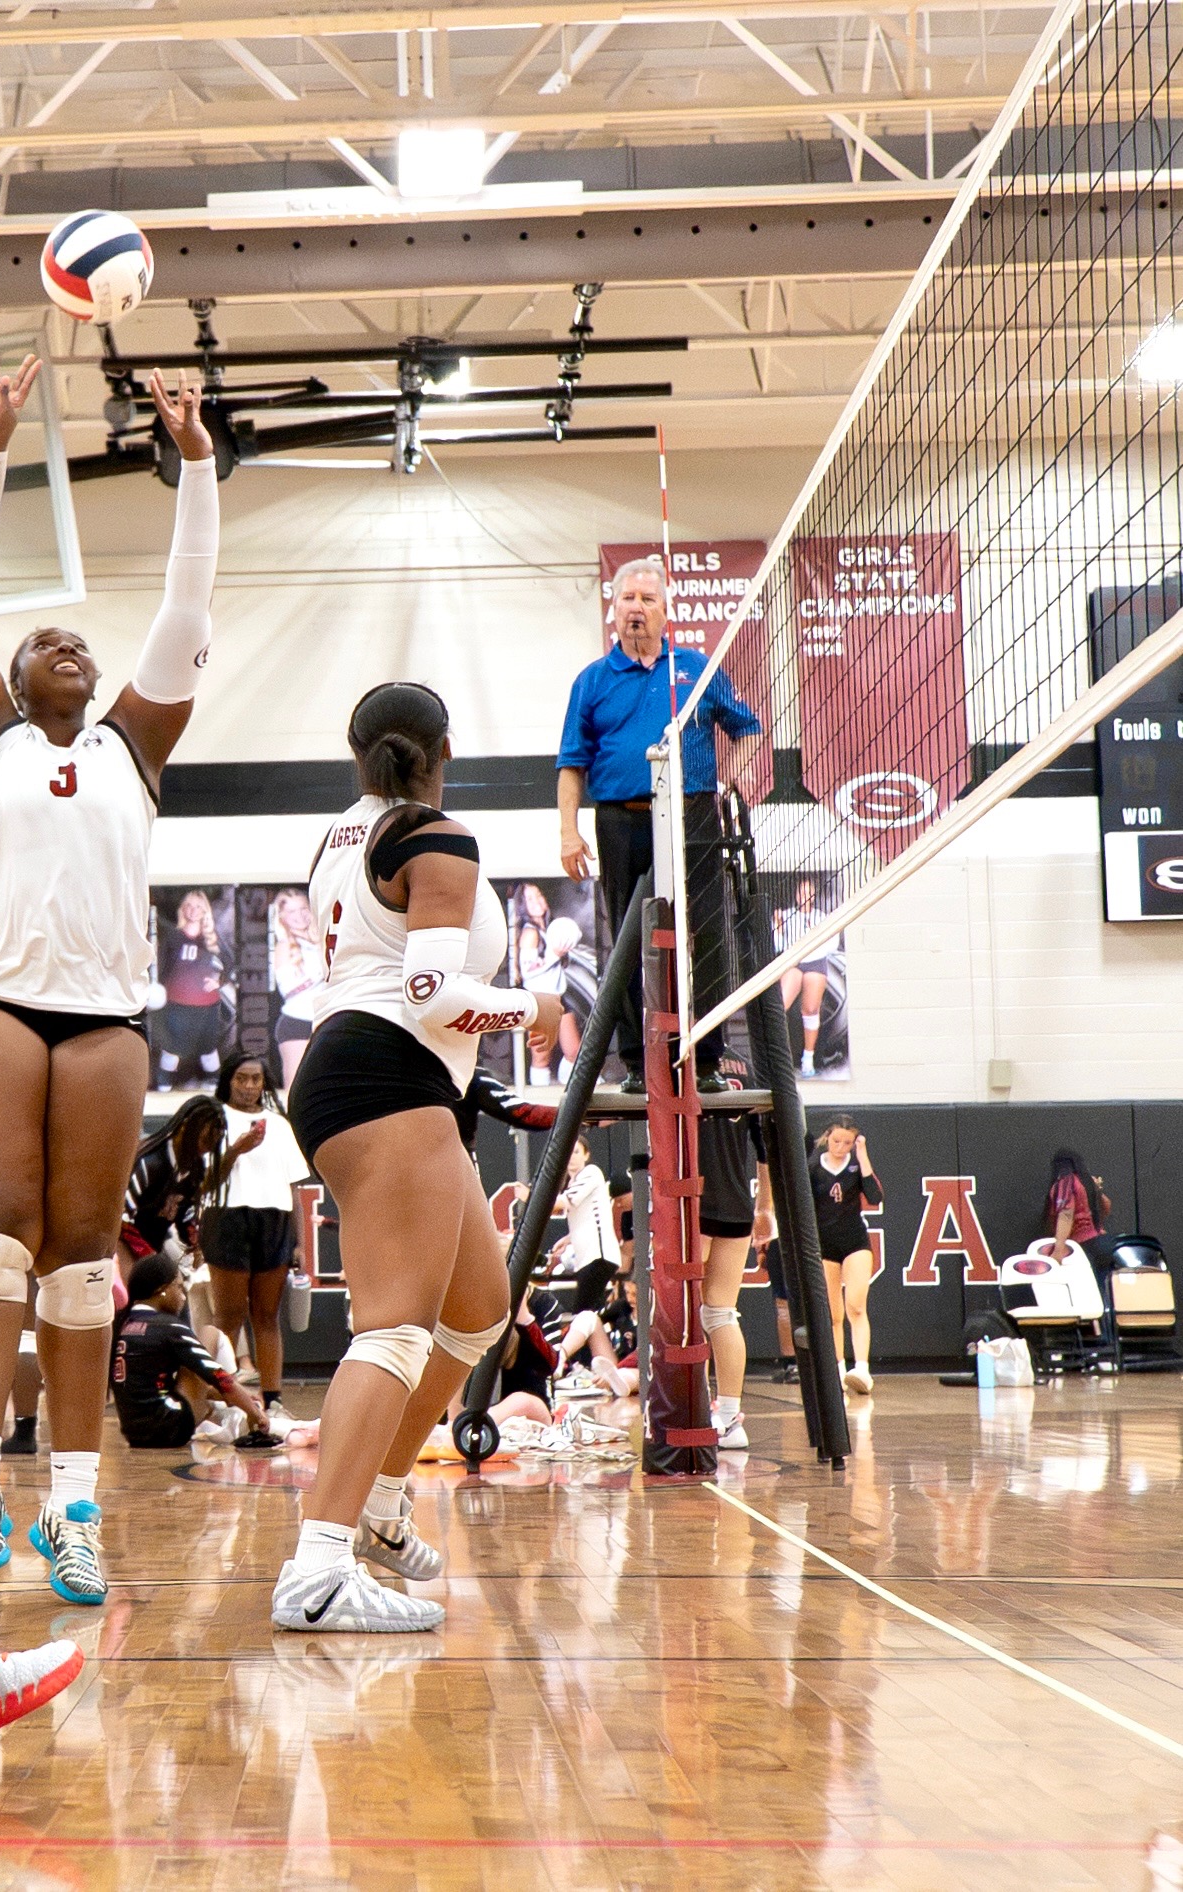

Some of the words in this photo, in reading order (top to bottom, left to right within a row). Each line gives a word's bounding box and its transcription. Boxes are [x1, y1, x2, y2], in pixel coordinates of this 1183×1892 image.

[647, 553, 721, 572] RLS
[838, 545, 915, 567] GIRLS
[834, 570, 919, 592] STATE
[800, 594, 957, 618] CHAMPIONS
[666, 630, 706, 643] 998
[1113, 718, 1162, 740] fouls
[1122, 807, 1162, 825] won
[830, 1182, 843, 1202] 4
